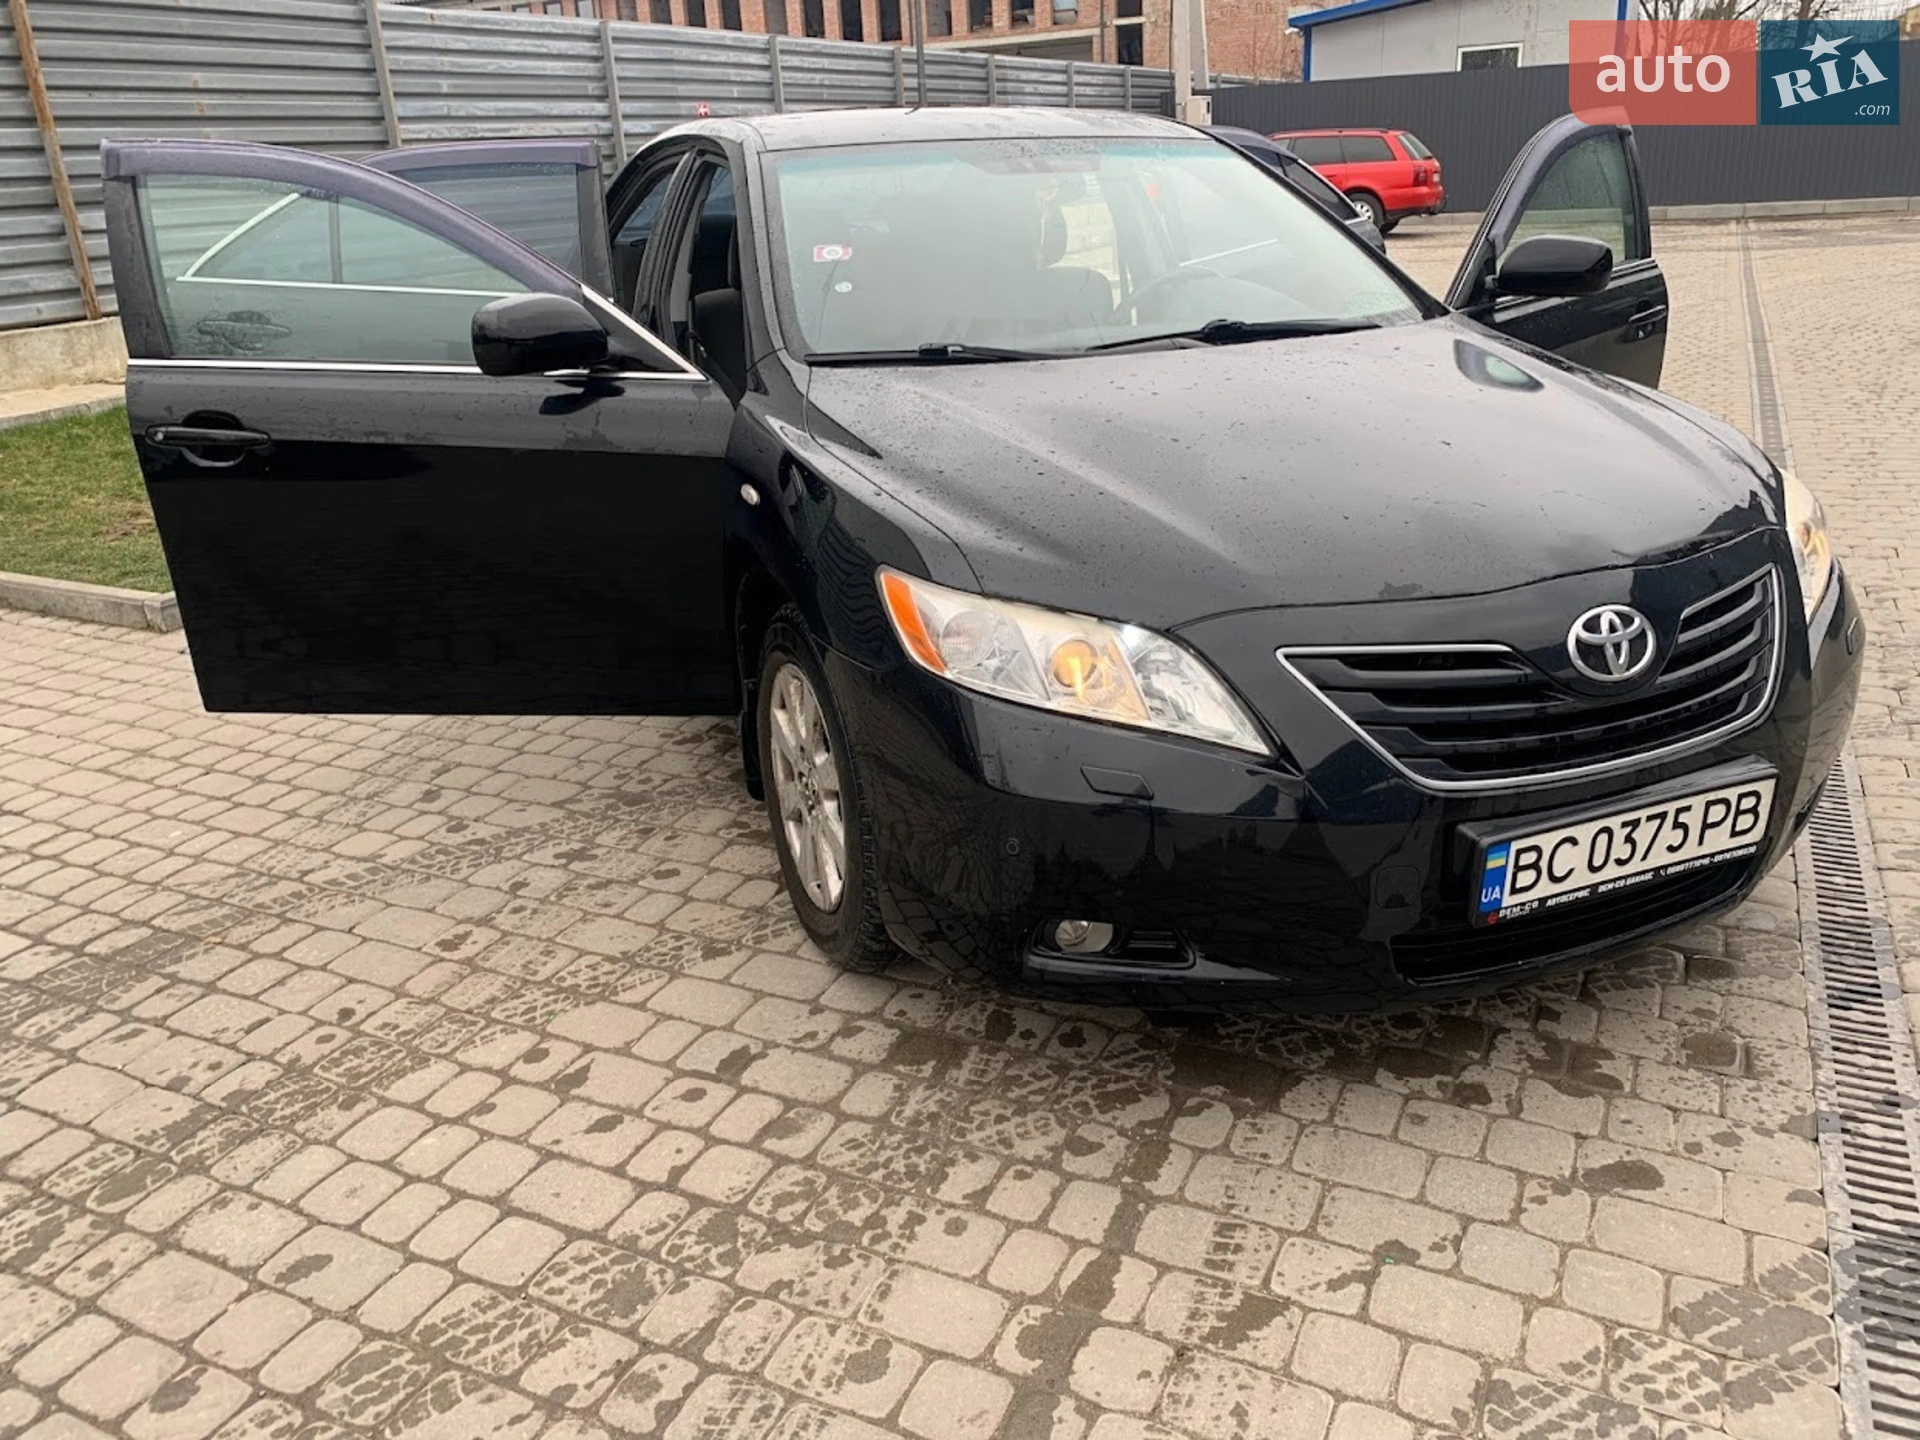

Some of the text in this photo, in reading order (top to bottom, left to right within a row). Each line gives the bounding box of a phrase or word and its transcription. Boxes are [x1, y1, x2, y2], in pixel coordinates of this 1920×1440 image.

[1509, 789, 1762, 896] BC 0375 PB
[1481, 885, 1501, 903] UA
